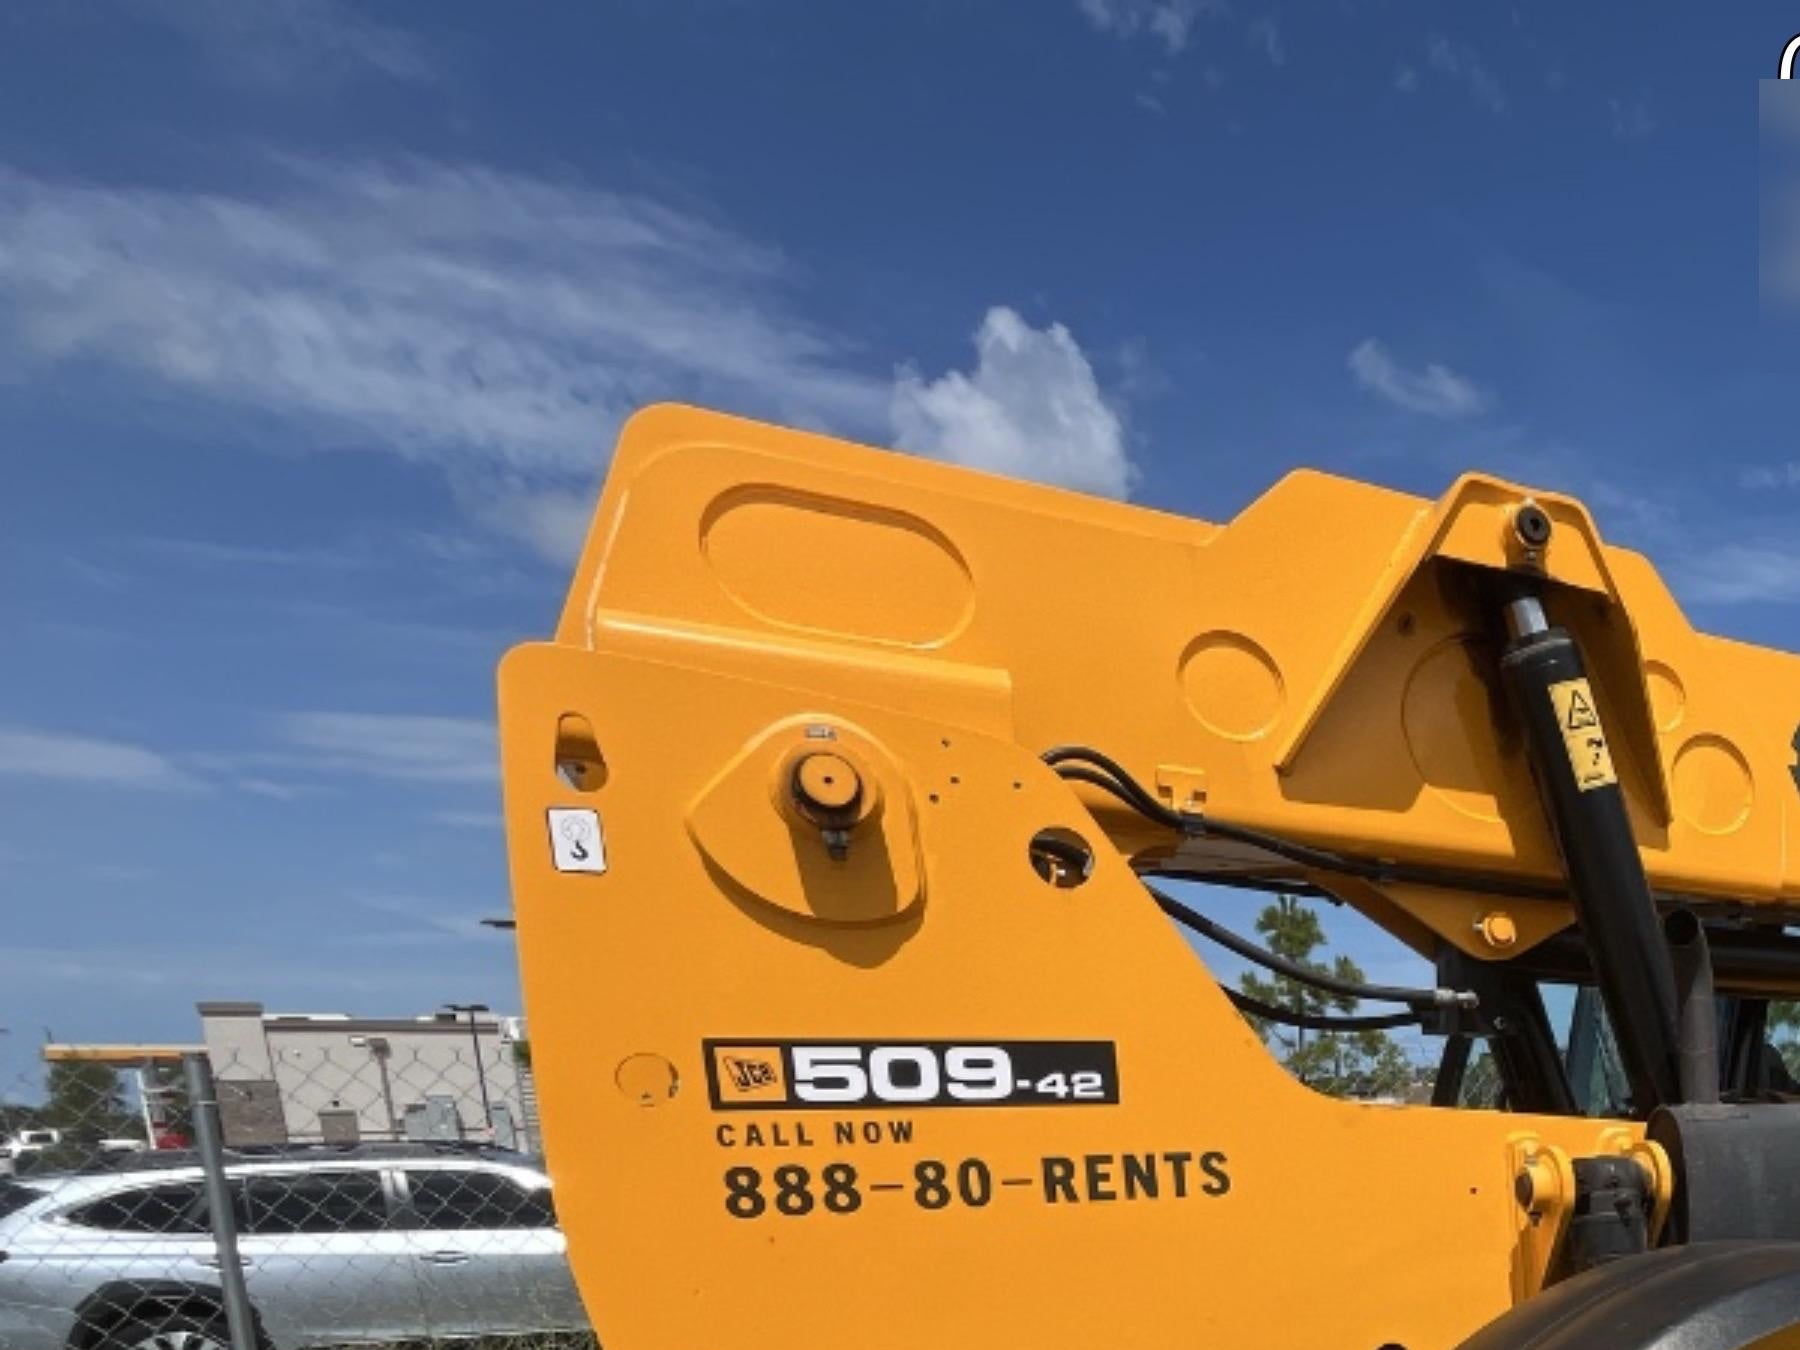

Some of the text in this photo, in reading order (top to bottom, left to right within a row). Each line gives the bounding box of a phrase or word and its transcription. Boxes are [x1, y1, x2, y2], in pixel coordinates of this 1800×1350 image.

[791, 1045, 1105, 1102] 509-42
[716, 1121, 914, 1147] CALL NOW
[724, 1151, 1231, 1219] 888-80-RENTS
